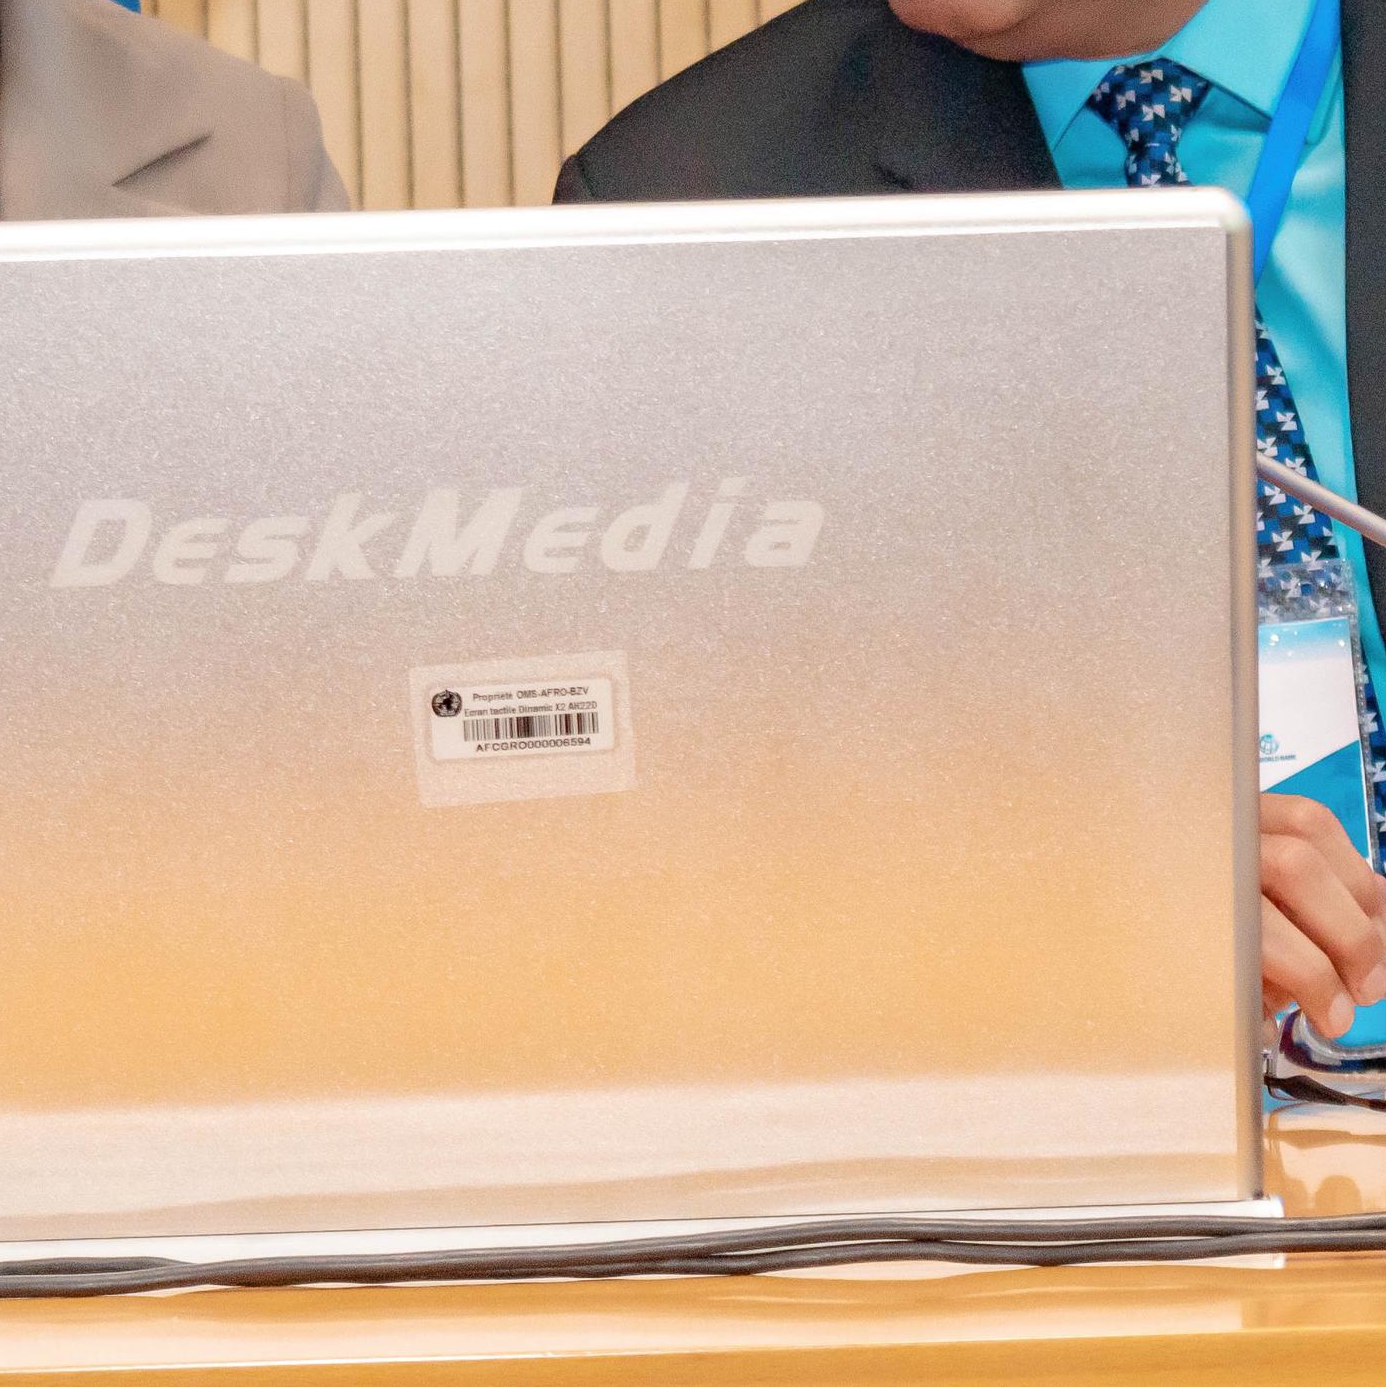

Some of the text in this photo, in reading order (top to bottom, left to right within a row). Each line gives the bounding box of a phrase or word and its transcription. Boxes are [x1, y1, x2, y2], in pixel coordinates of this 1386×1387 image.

[48, 477, 825, 588] DeskMedia
[490, 706, 516, 715] tactile
[555, 701, 566, 711] X2
